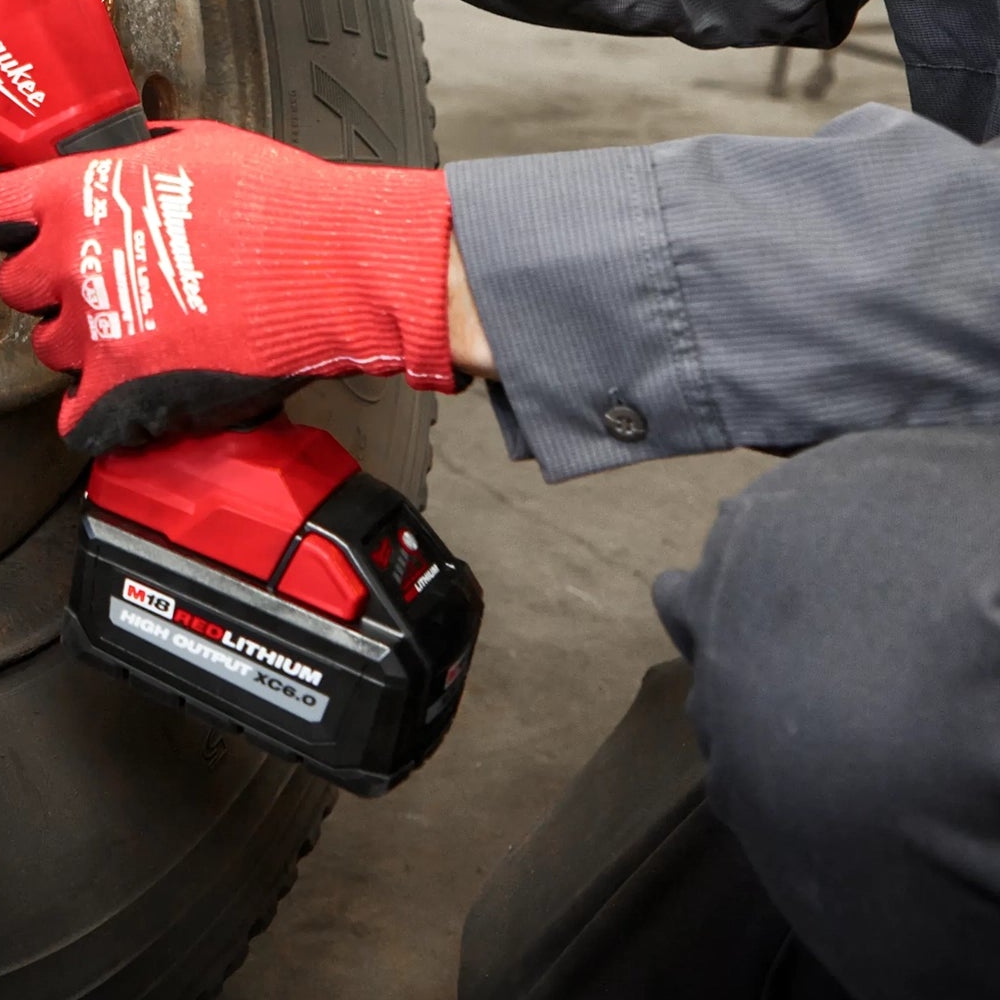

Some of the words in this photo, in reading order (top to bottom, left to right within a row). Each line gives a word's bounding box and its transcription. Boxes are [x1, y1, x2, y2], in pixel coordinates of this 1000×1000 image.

[134, 230, 147, 262] CUT
[153, 164, 208, 314] Milwaukee
[126, 584, 171, 614] M18
[120, 609, 171, 640] HIGH
[172, 628, 254, 677] OUTPUT
[254, 671, 317, 708] XC6.0
